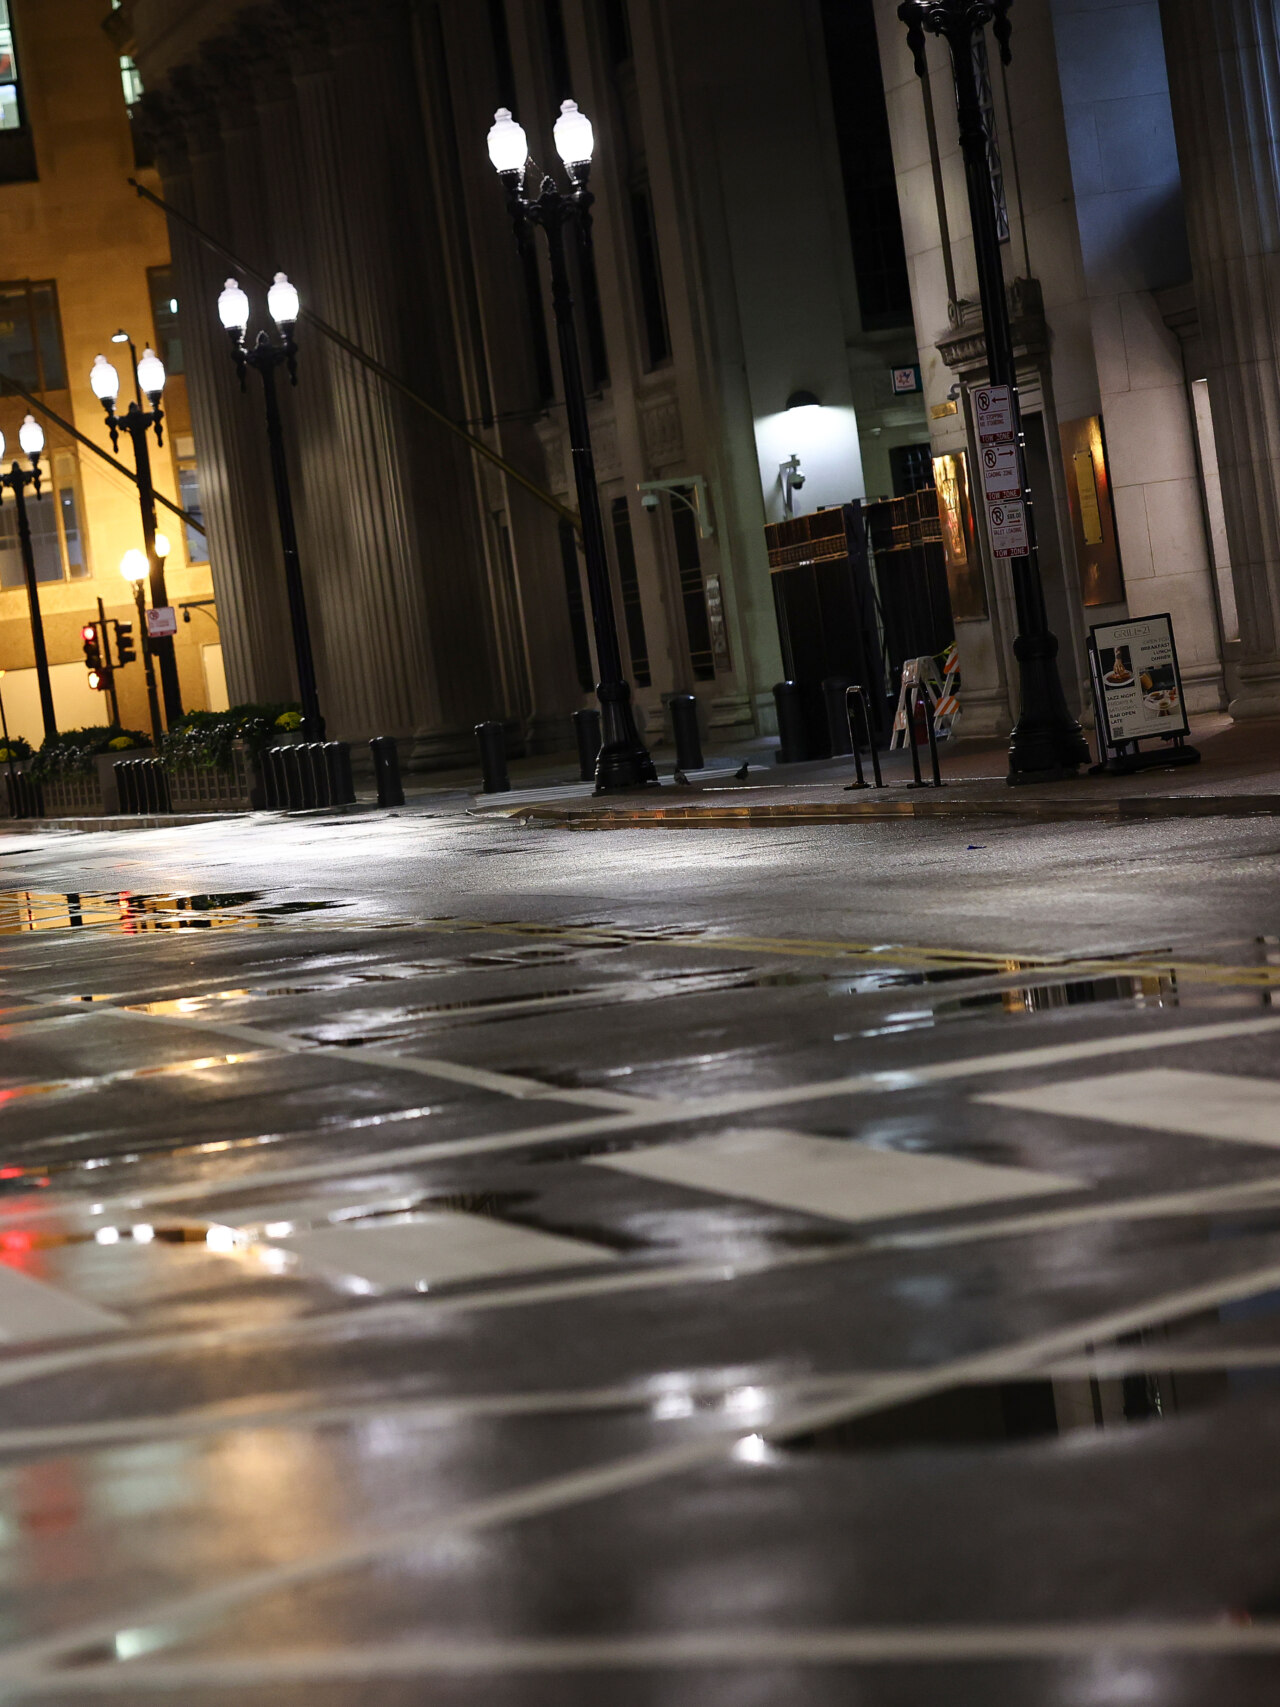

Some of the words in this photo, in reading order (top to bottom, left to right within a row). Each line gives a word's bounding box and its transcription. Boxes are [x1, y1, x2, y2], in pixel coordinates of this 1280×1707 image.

[982, 434, 995, 442] TOW
[996, 432, 1010, 440] ZONE
[989, 492, 1001, 500] TOW
[1003, 490, 1018, 498] ZONE
[1006, 526, 1022, 534] LOADING
[996, 549, 1008, 557] TOW
[1010, 547, 1025, 556] ZONE
[1141, 643, 1171, 651] BREAKFAST
